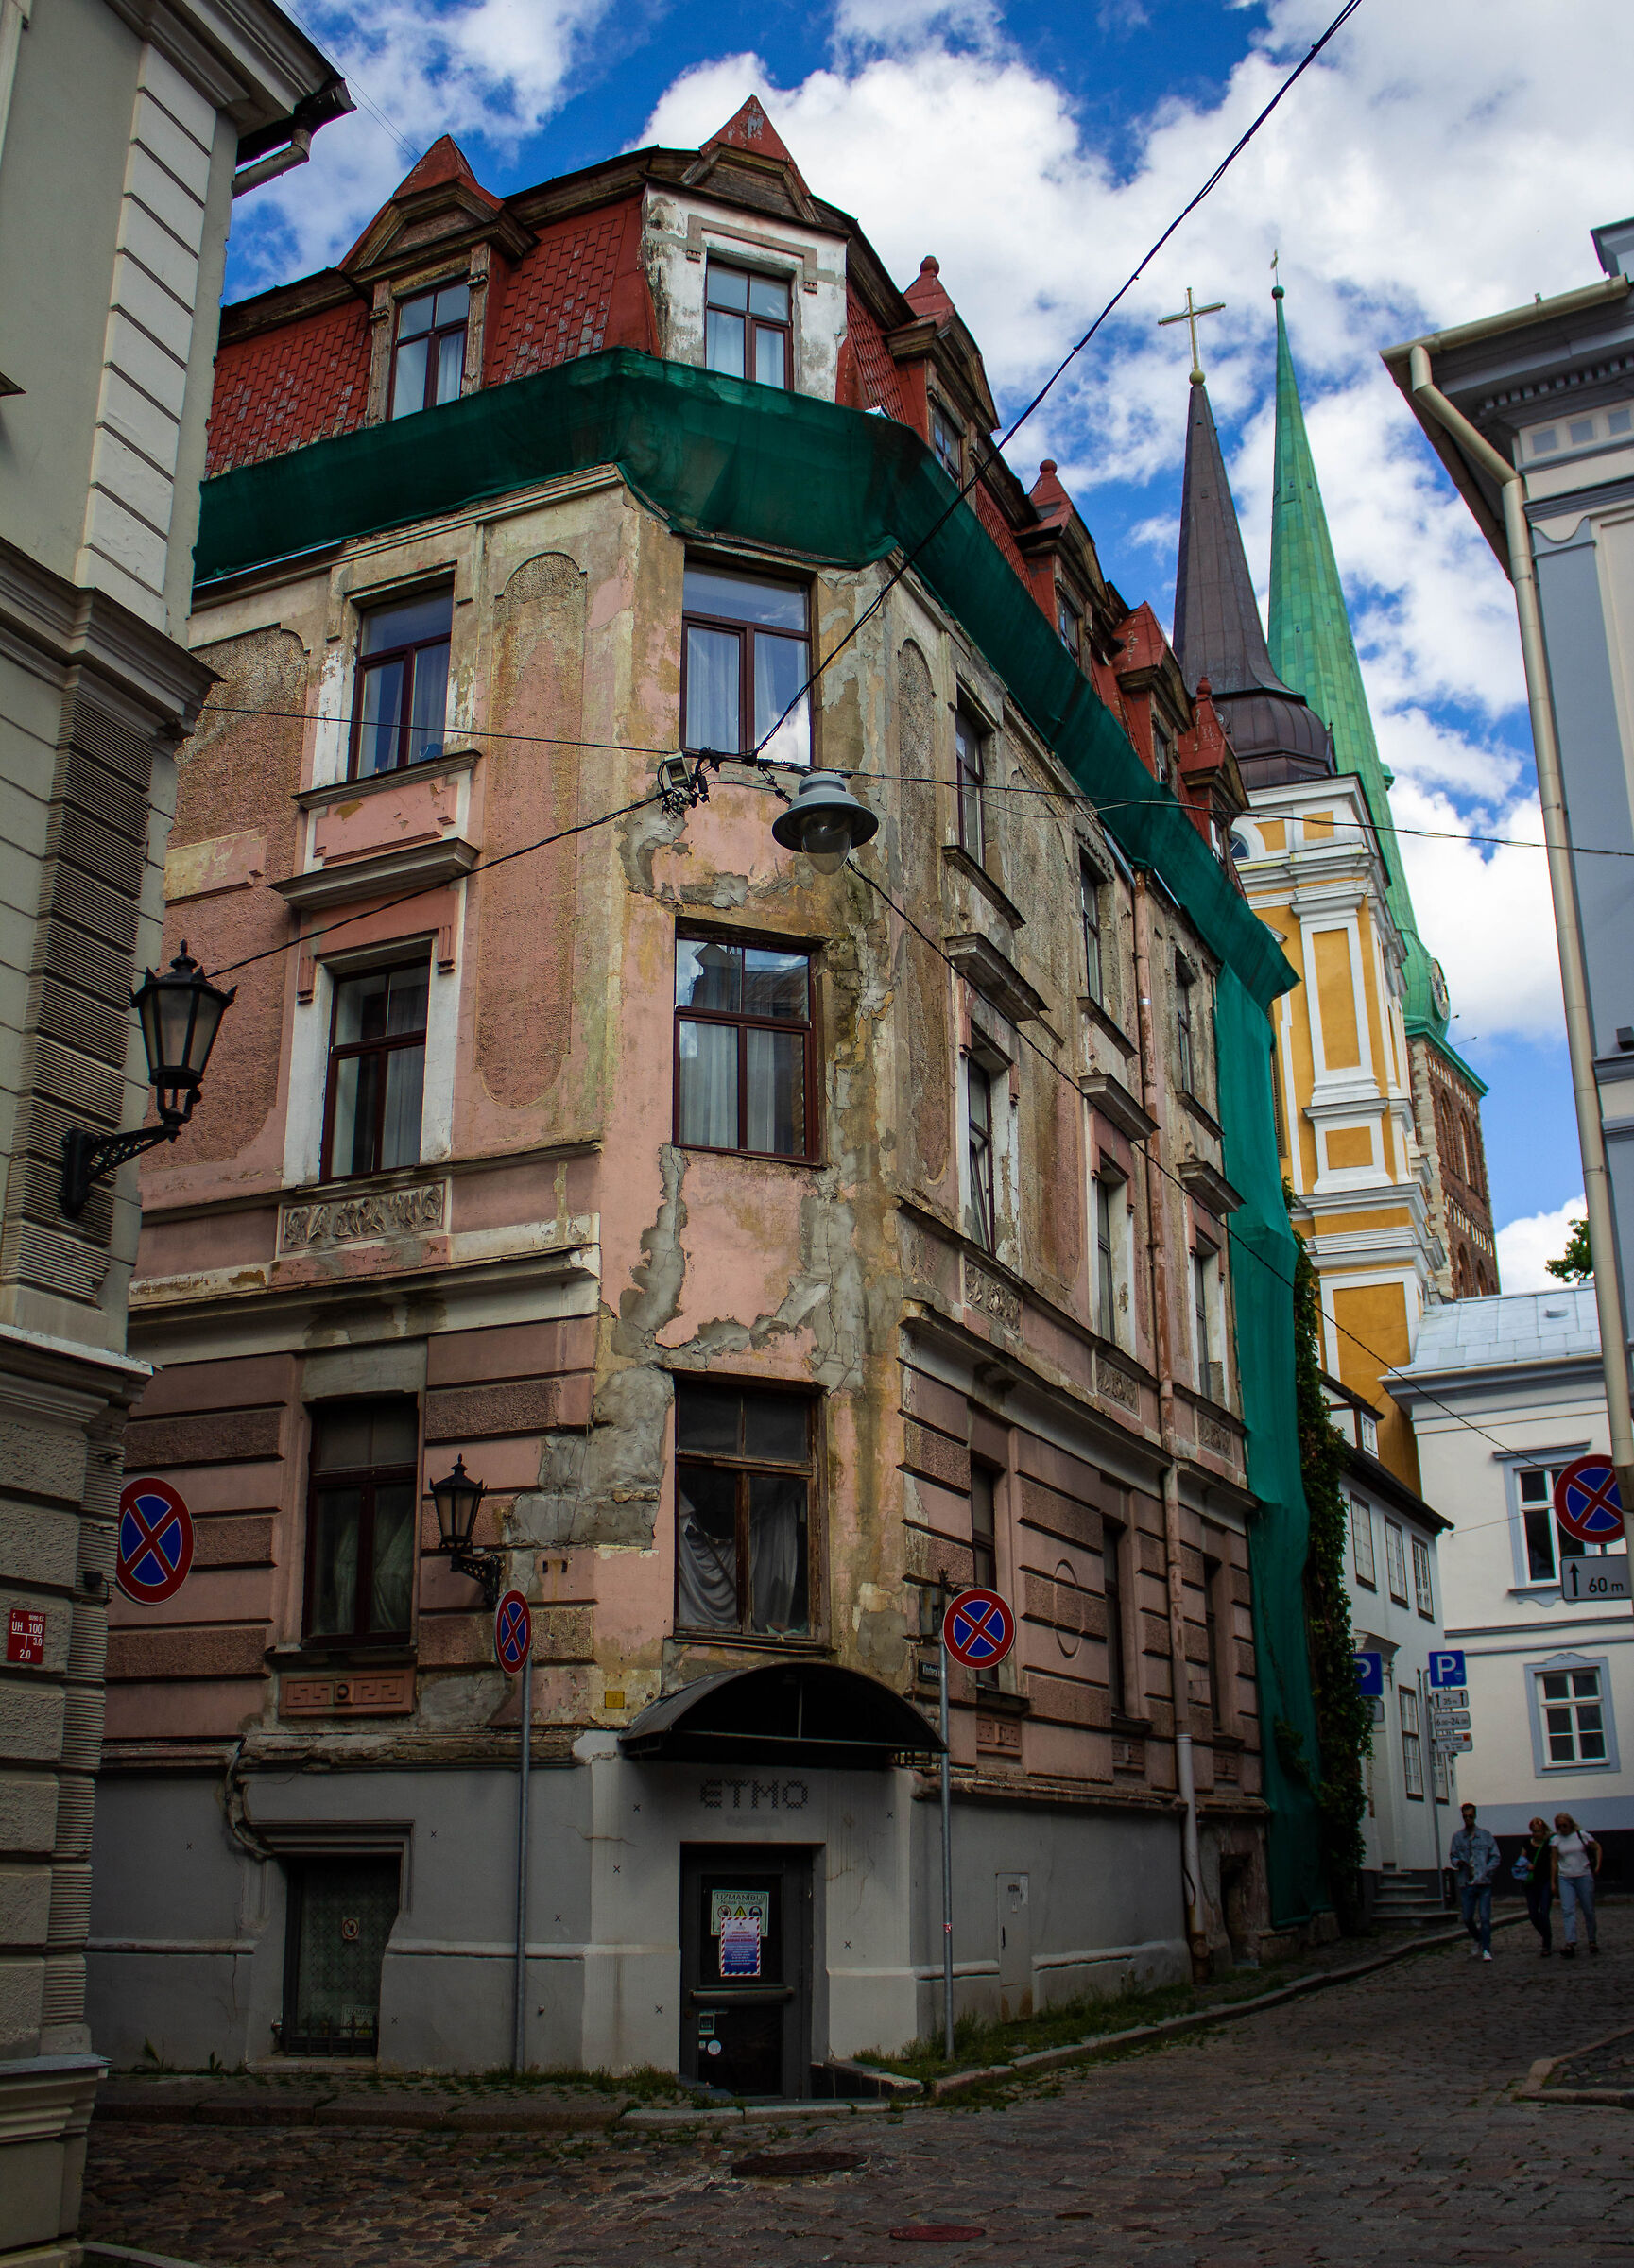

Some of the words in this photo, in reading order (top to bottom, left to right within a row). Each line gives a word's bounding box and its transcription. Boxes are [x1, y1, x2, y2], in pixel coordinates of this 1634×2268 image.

[1589, 1577, 1608, 1593] 60
[1611, 1583, 1624, 1592] m
[11, 1621, 23, 1632] UH
[28, 1623, 43, 1635] 100
[33, 1637, 43, 1647] 3.0
[19, 1648, 31, 1660] 2.0
[1436, 1655, 1457, 1683] P
[700, 1779, 808, 1809] ETMO
